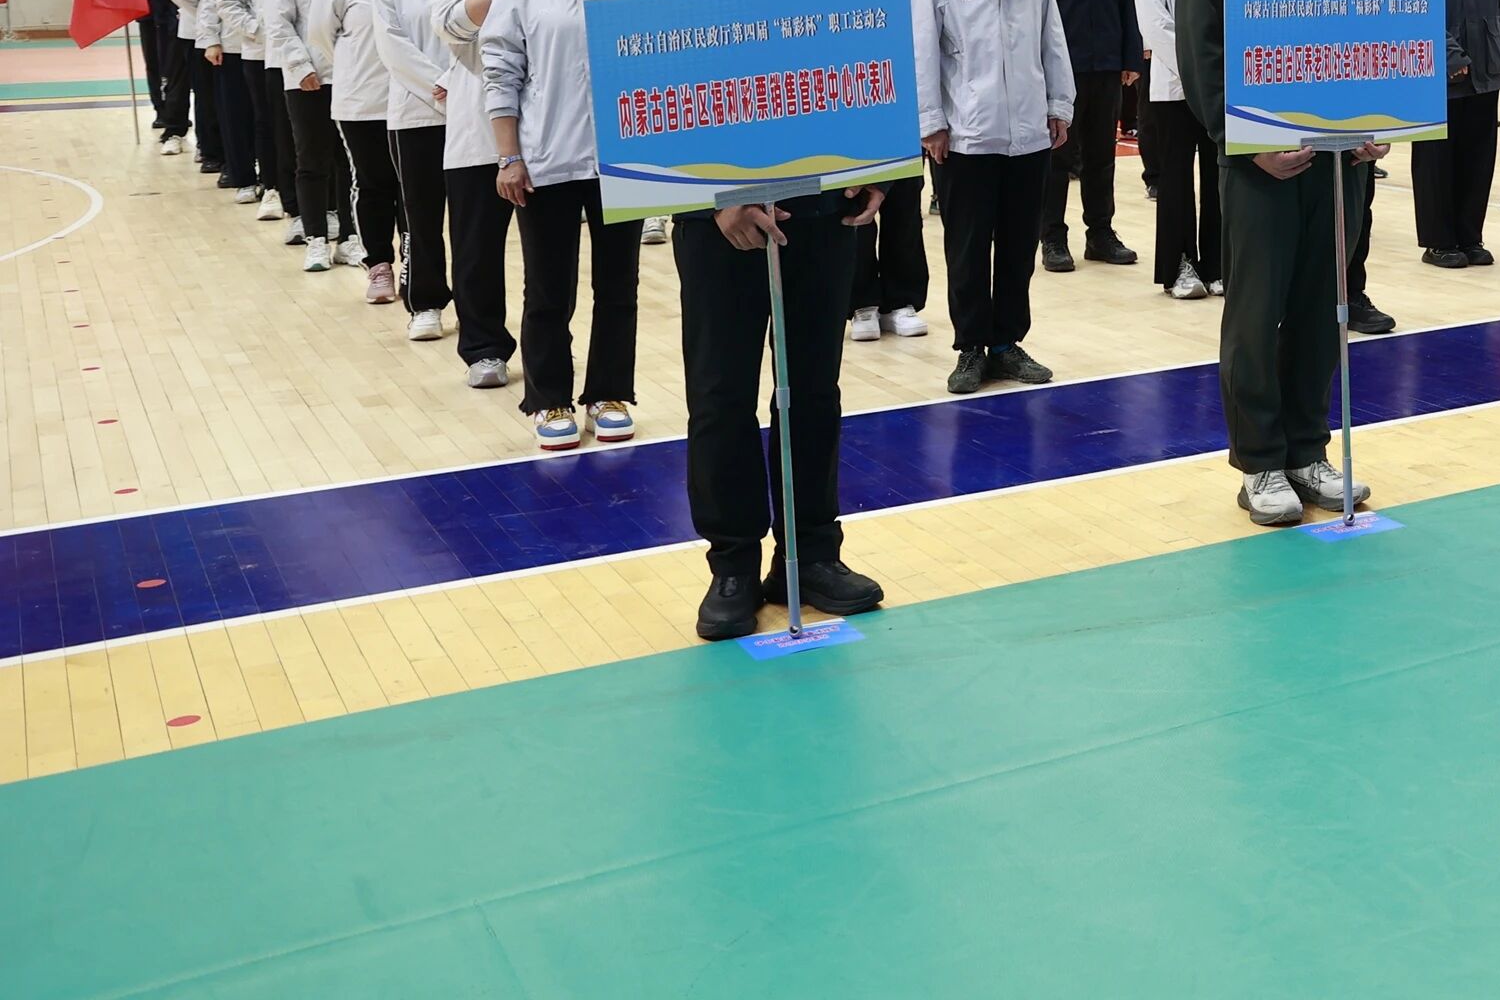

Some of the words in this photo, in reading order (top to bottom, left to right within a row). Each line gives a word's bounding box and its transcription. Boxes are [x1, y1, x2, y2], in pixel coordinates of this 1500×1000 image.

[617, 58, 896, 140] 内蒙古自治区福利彩票销售管理中心代表队
